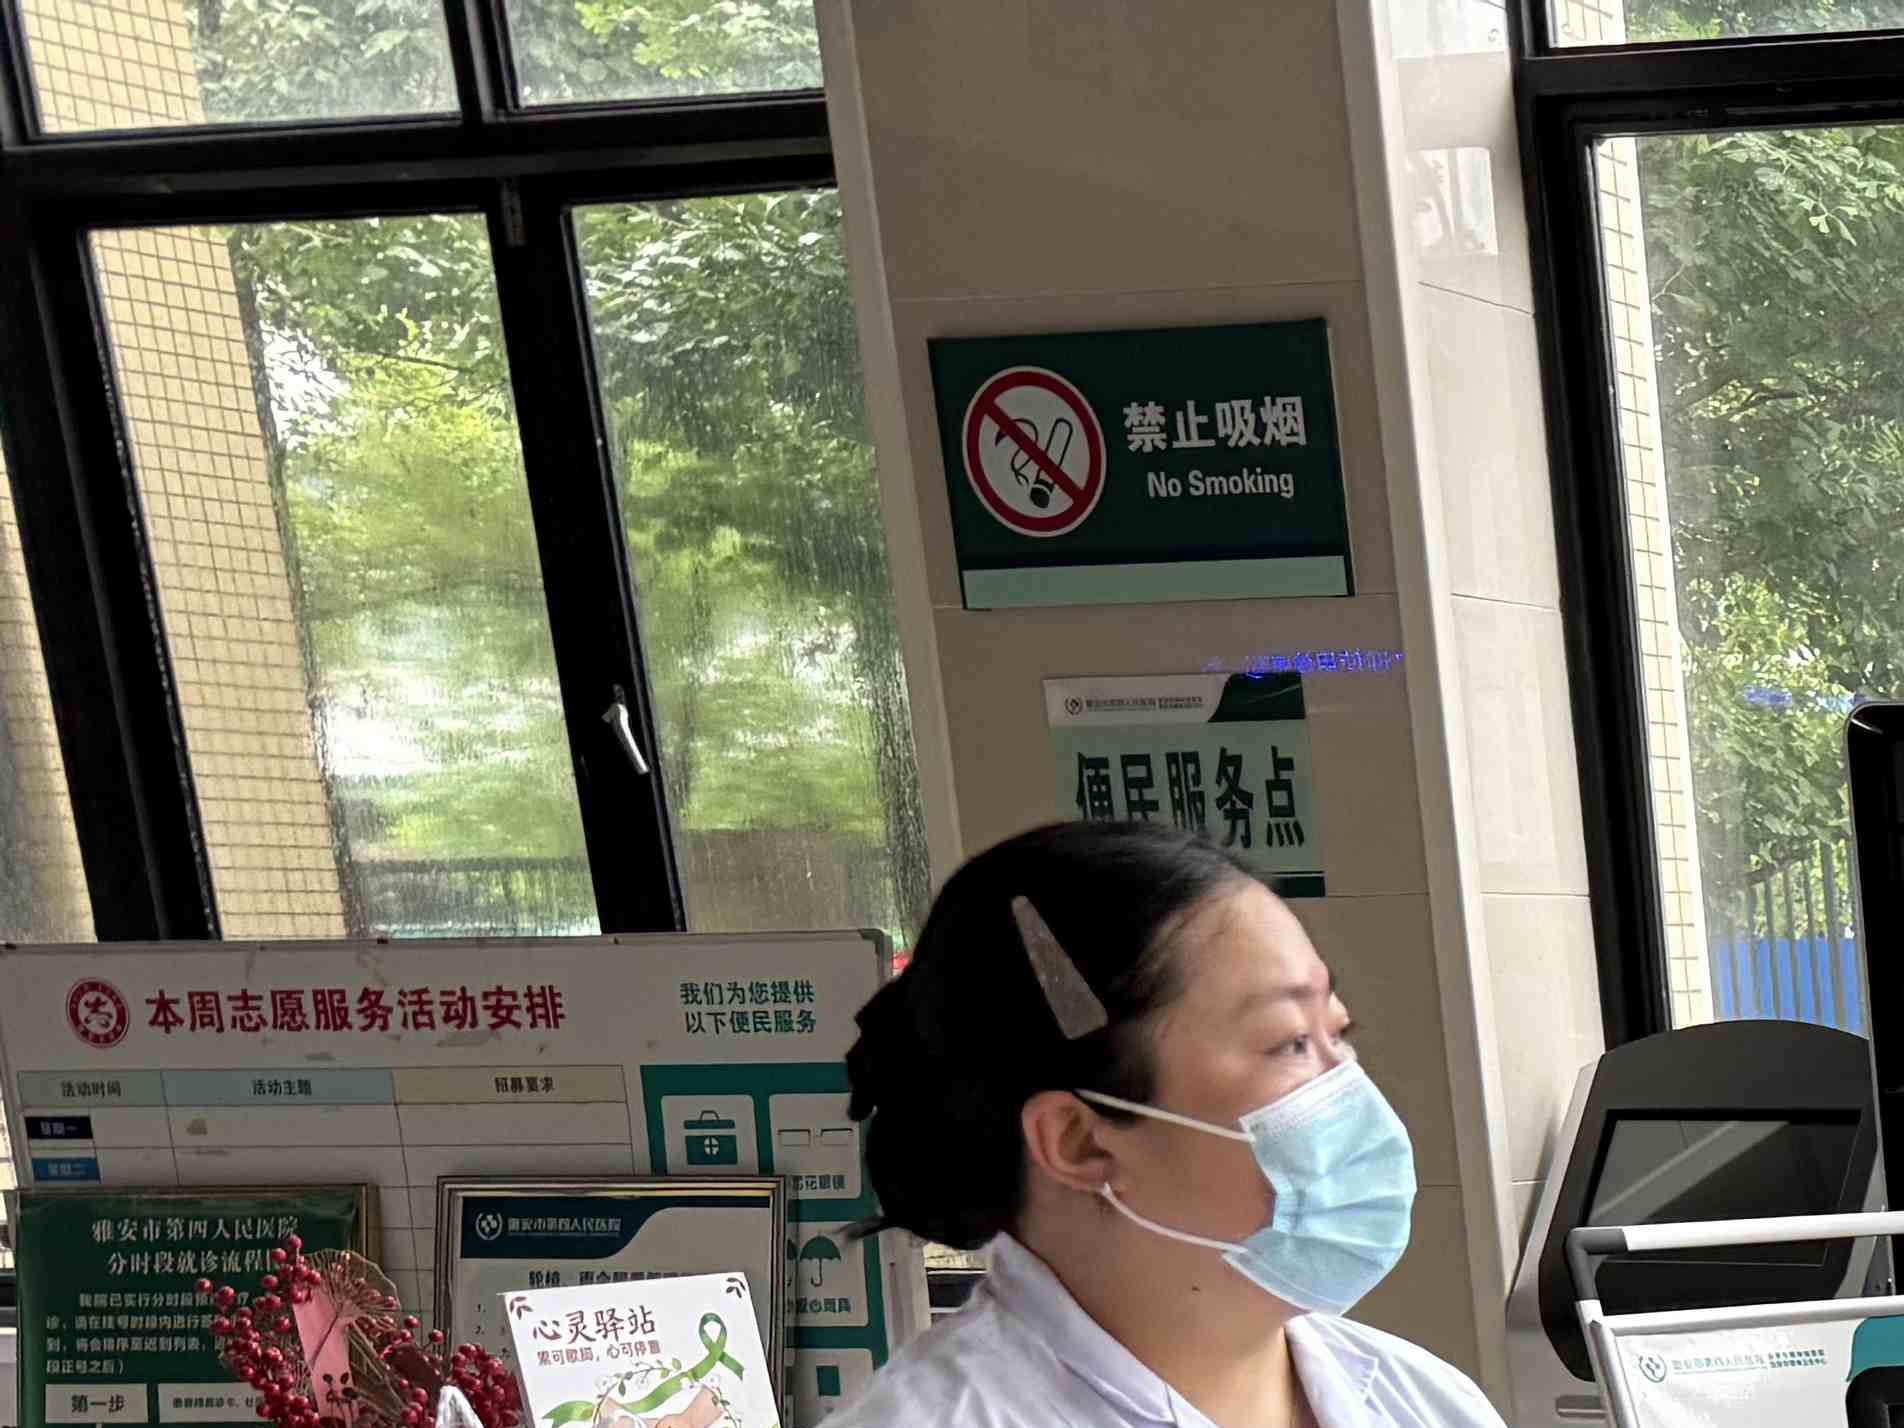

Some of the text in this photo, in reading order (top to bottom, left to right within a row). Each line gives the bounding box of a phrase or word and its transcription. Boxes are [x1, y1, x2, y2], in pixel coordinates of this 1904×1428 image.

[1123, 395, 1307, 454] 禁止吸烟
[1147, 466, 1295, 498] No Smoking
[1076, 745, 1305, 848] 便民服务点
[680, 979, 816, 1005] 我们为您提供
[146, 985, 566, 1034] 本周志愿服务活动安排
[685, 1010, 817, 1036] 以下便民服务
[92, 1215, 299, 1243] 雅安市第四人民医院
[532, 1304, 657, 1345] 心灵驿站
[70, 1394, 126, 1414] 第一步
